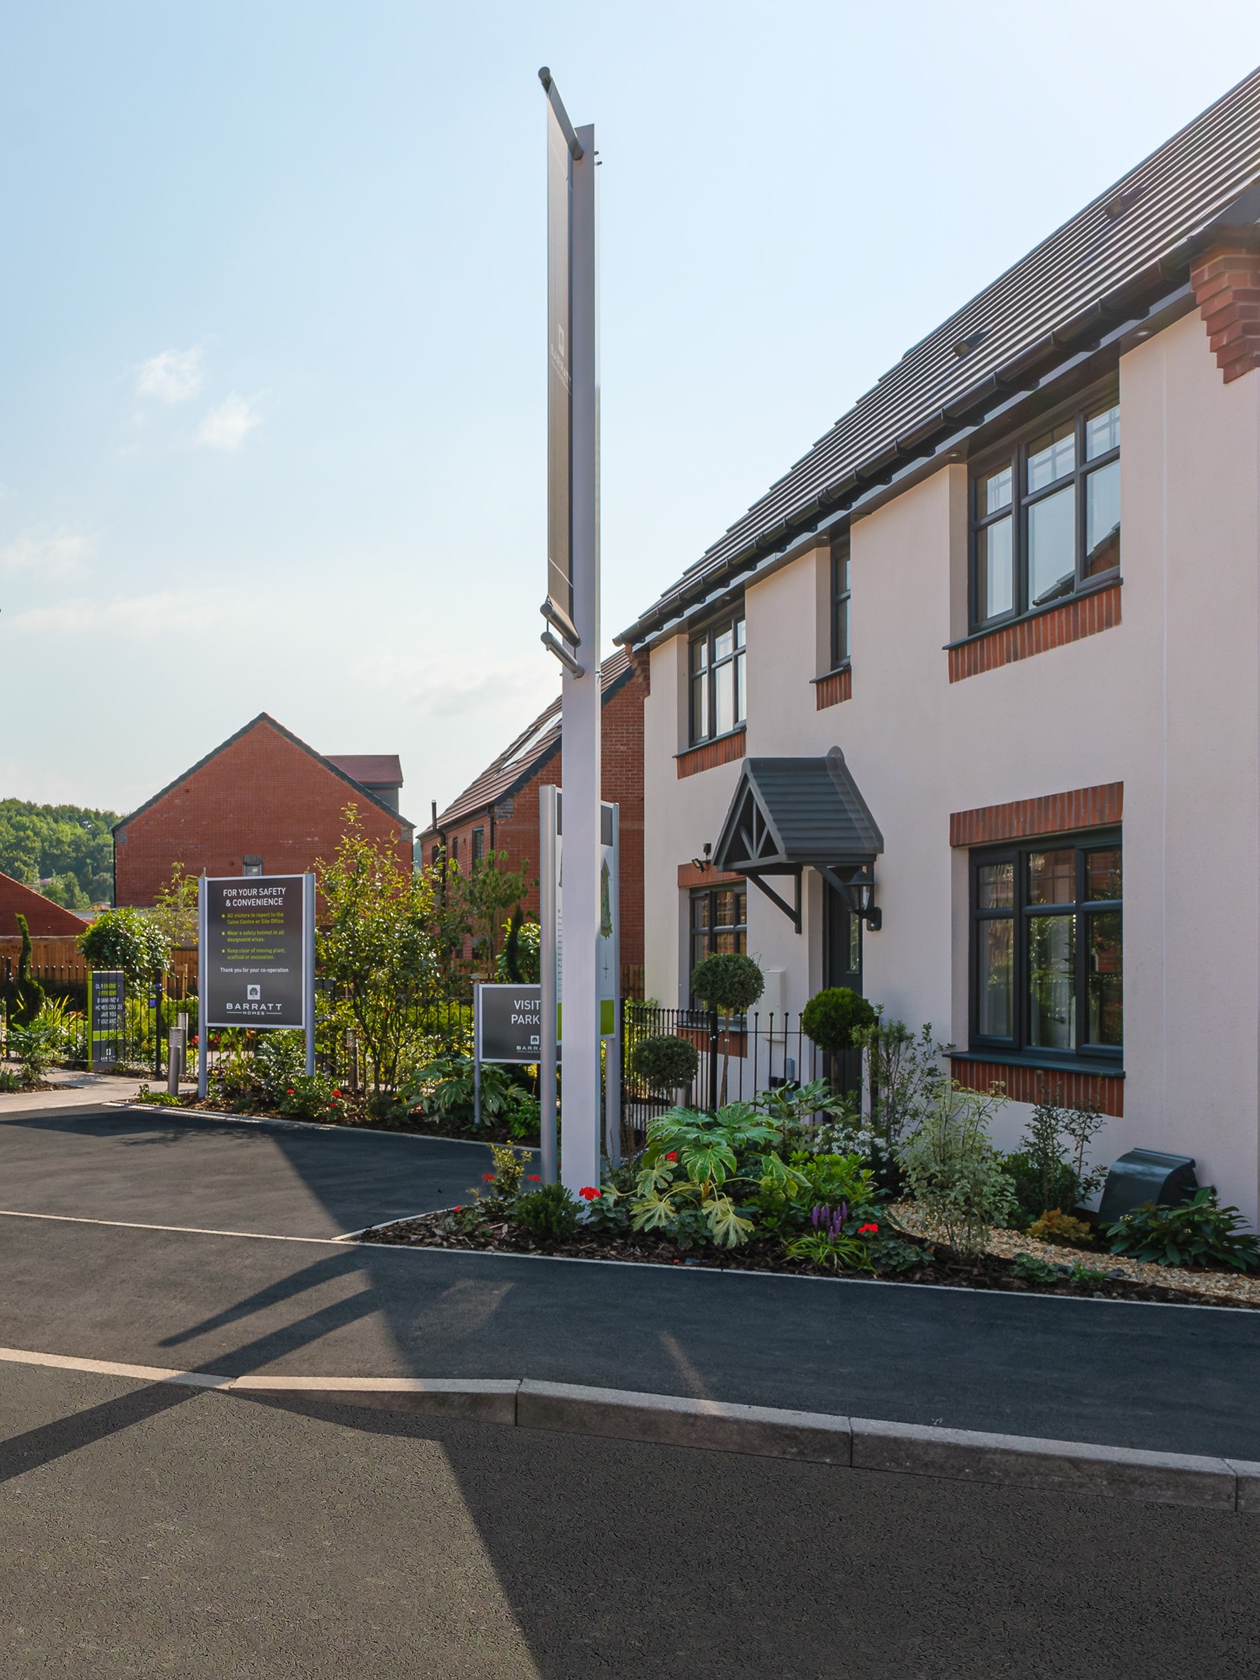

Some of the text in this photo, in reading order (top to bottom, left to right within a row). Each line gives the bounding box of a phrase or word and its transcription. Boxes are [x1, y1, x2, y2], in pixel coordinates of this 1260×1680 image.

[259, 888, 286, 896] SAFETY
[232, 898, 283, 906] CONVENIENCE
[514, 1000, 541, 1010] VISIT
[511, 1014, 540, 1024] PARK
